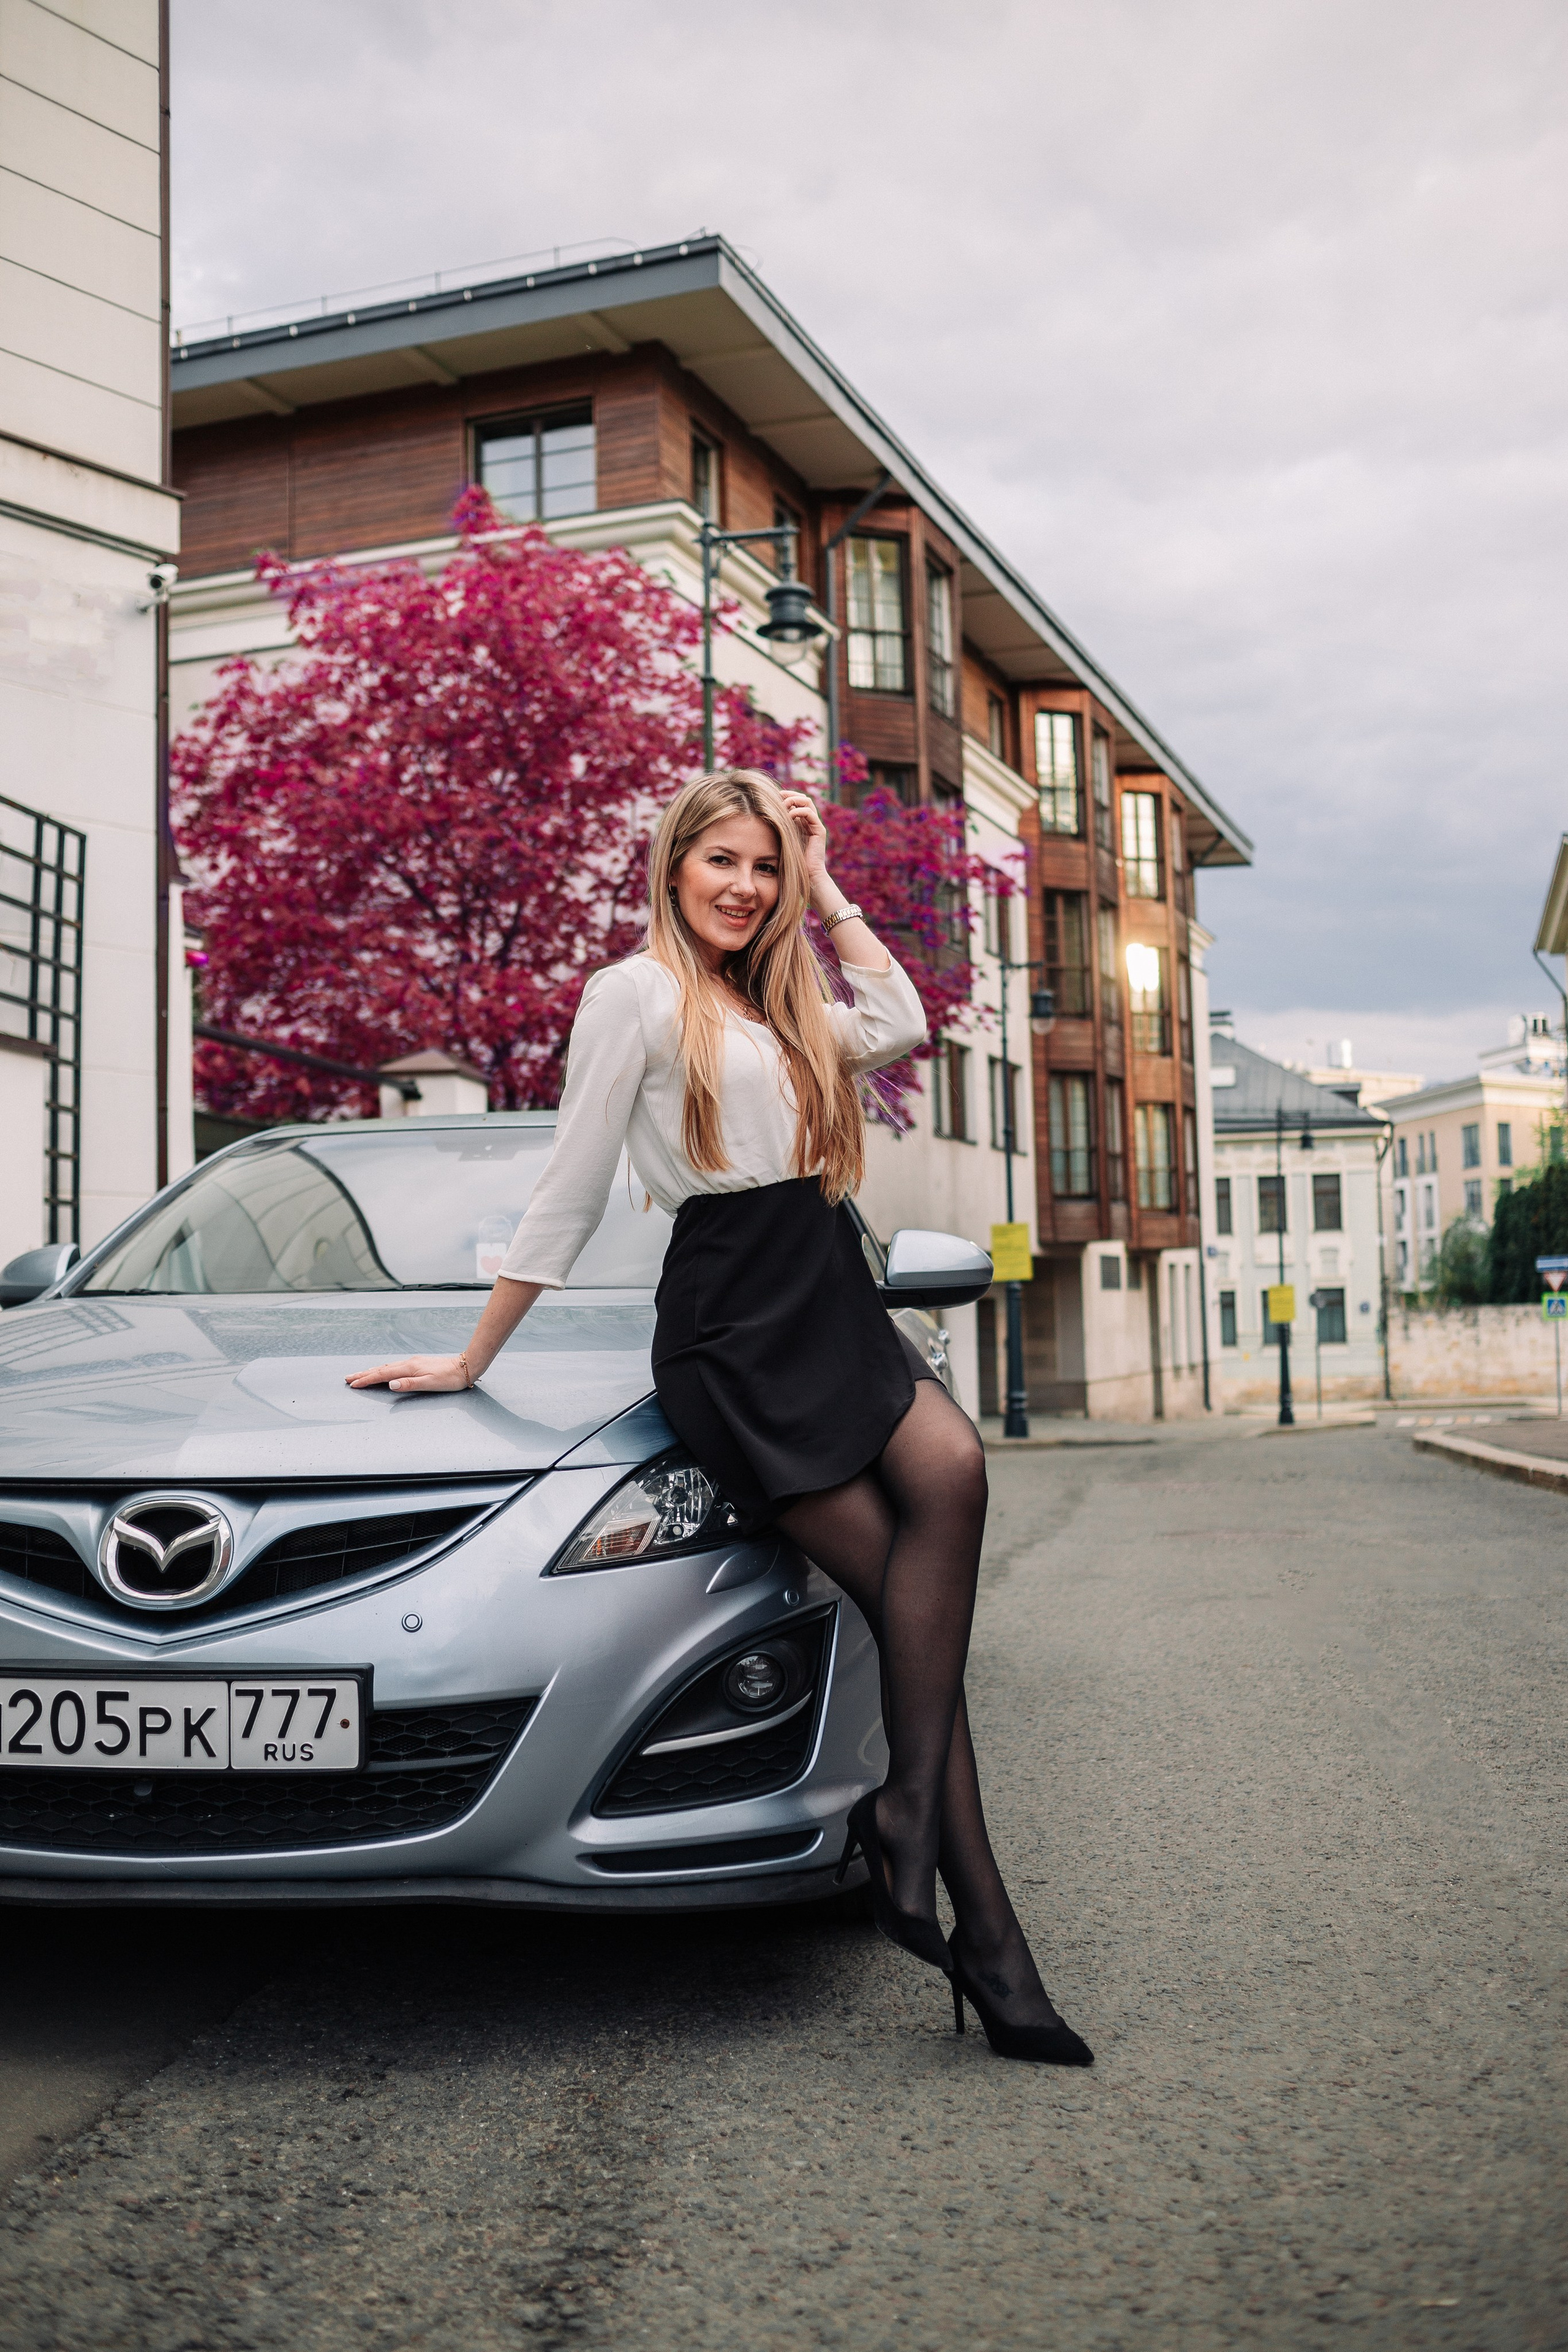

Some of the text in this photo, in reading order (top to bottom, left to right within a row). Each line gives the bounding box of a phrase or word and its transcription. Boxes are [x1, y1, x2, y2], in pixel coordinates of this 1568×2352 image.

[0, 1688, 336, 1758] 205PK 777
[263, 1743, 314, 1762] RUS
